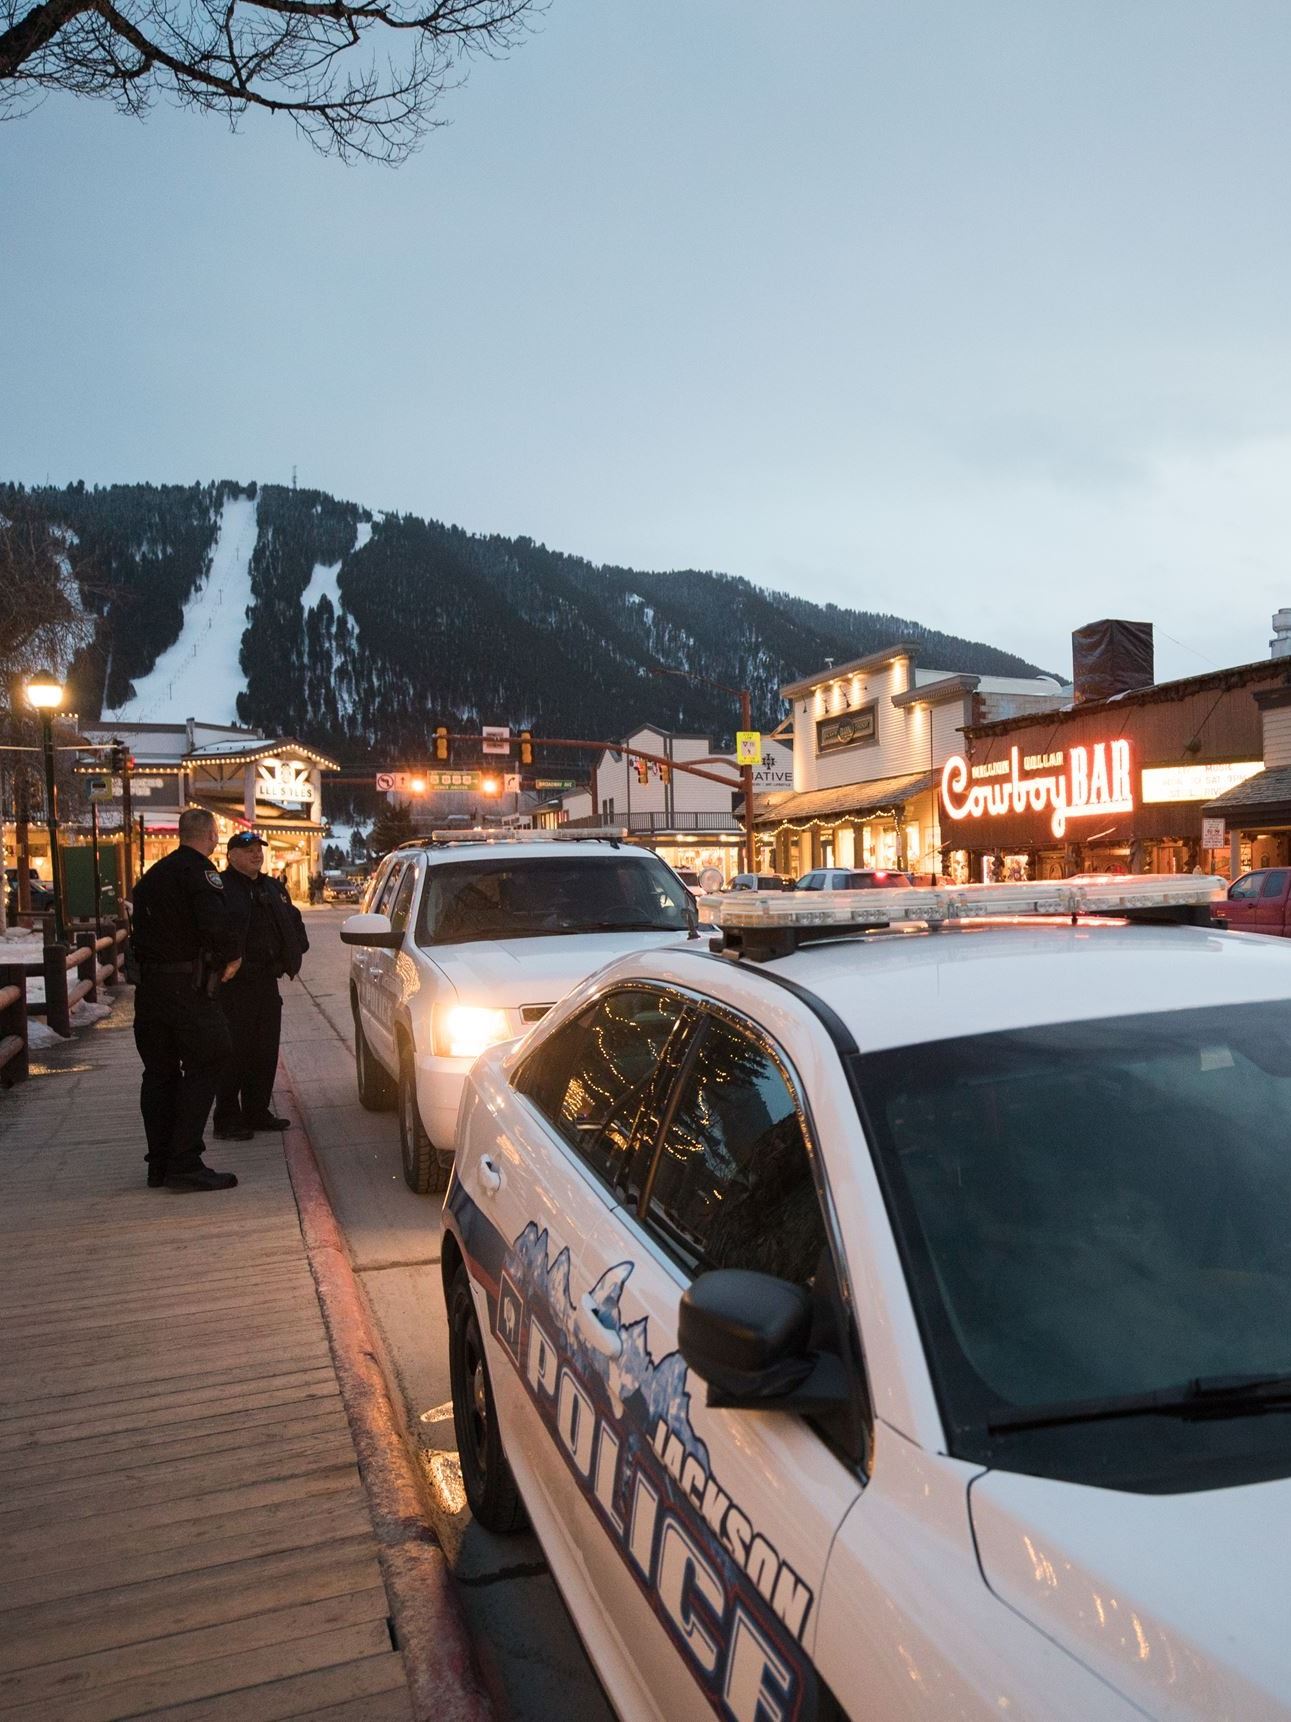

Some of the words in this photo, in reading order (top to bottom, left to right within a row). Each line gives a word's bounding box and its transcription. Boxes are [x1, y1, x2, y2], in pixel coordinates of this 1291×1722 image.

[751, 771, 793, 782] ATIVE
[941, 745, 1067, 838] Cowboy
[1069, 738, 1132, 806] BAR
[1023, 751, 1064, 771] DOLLAR
[647, 1418, 814, 1643] JACKSON
